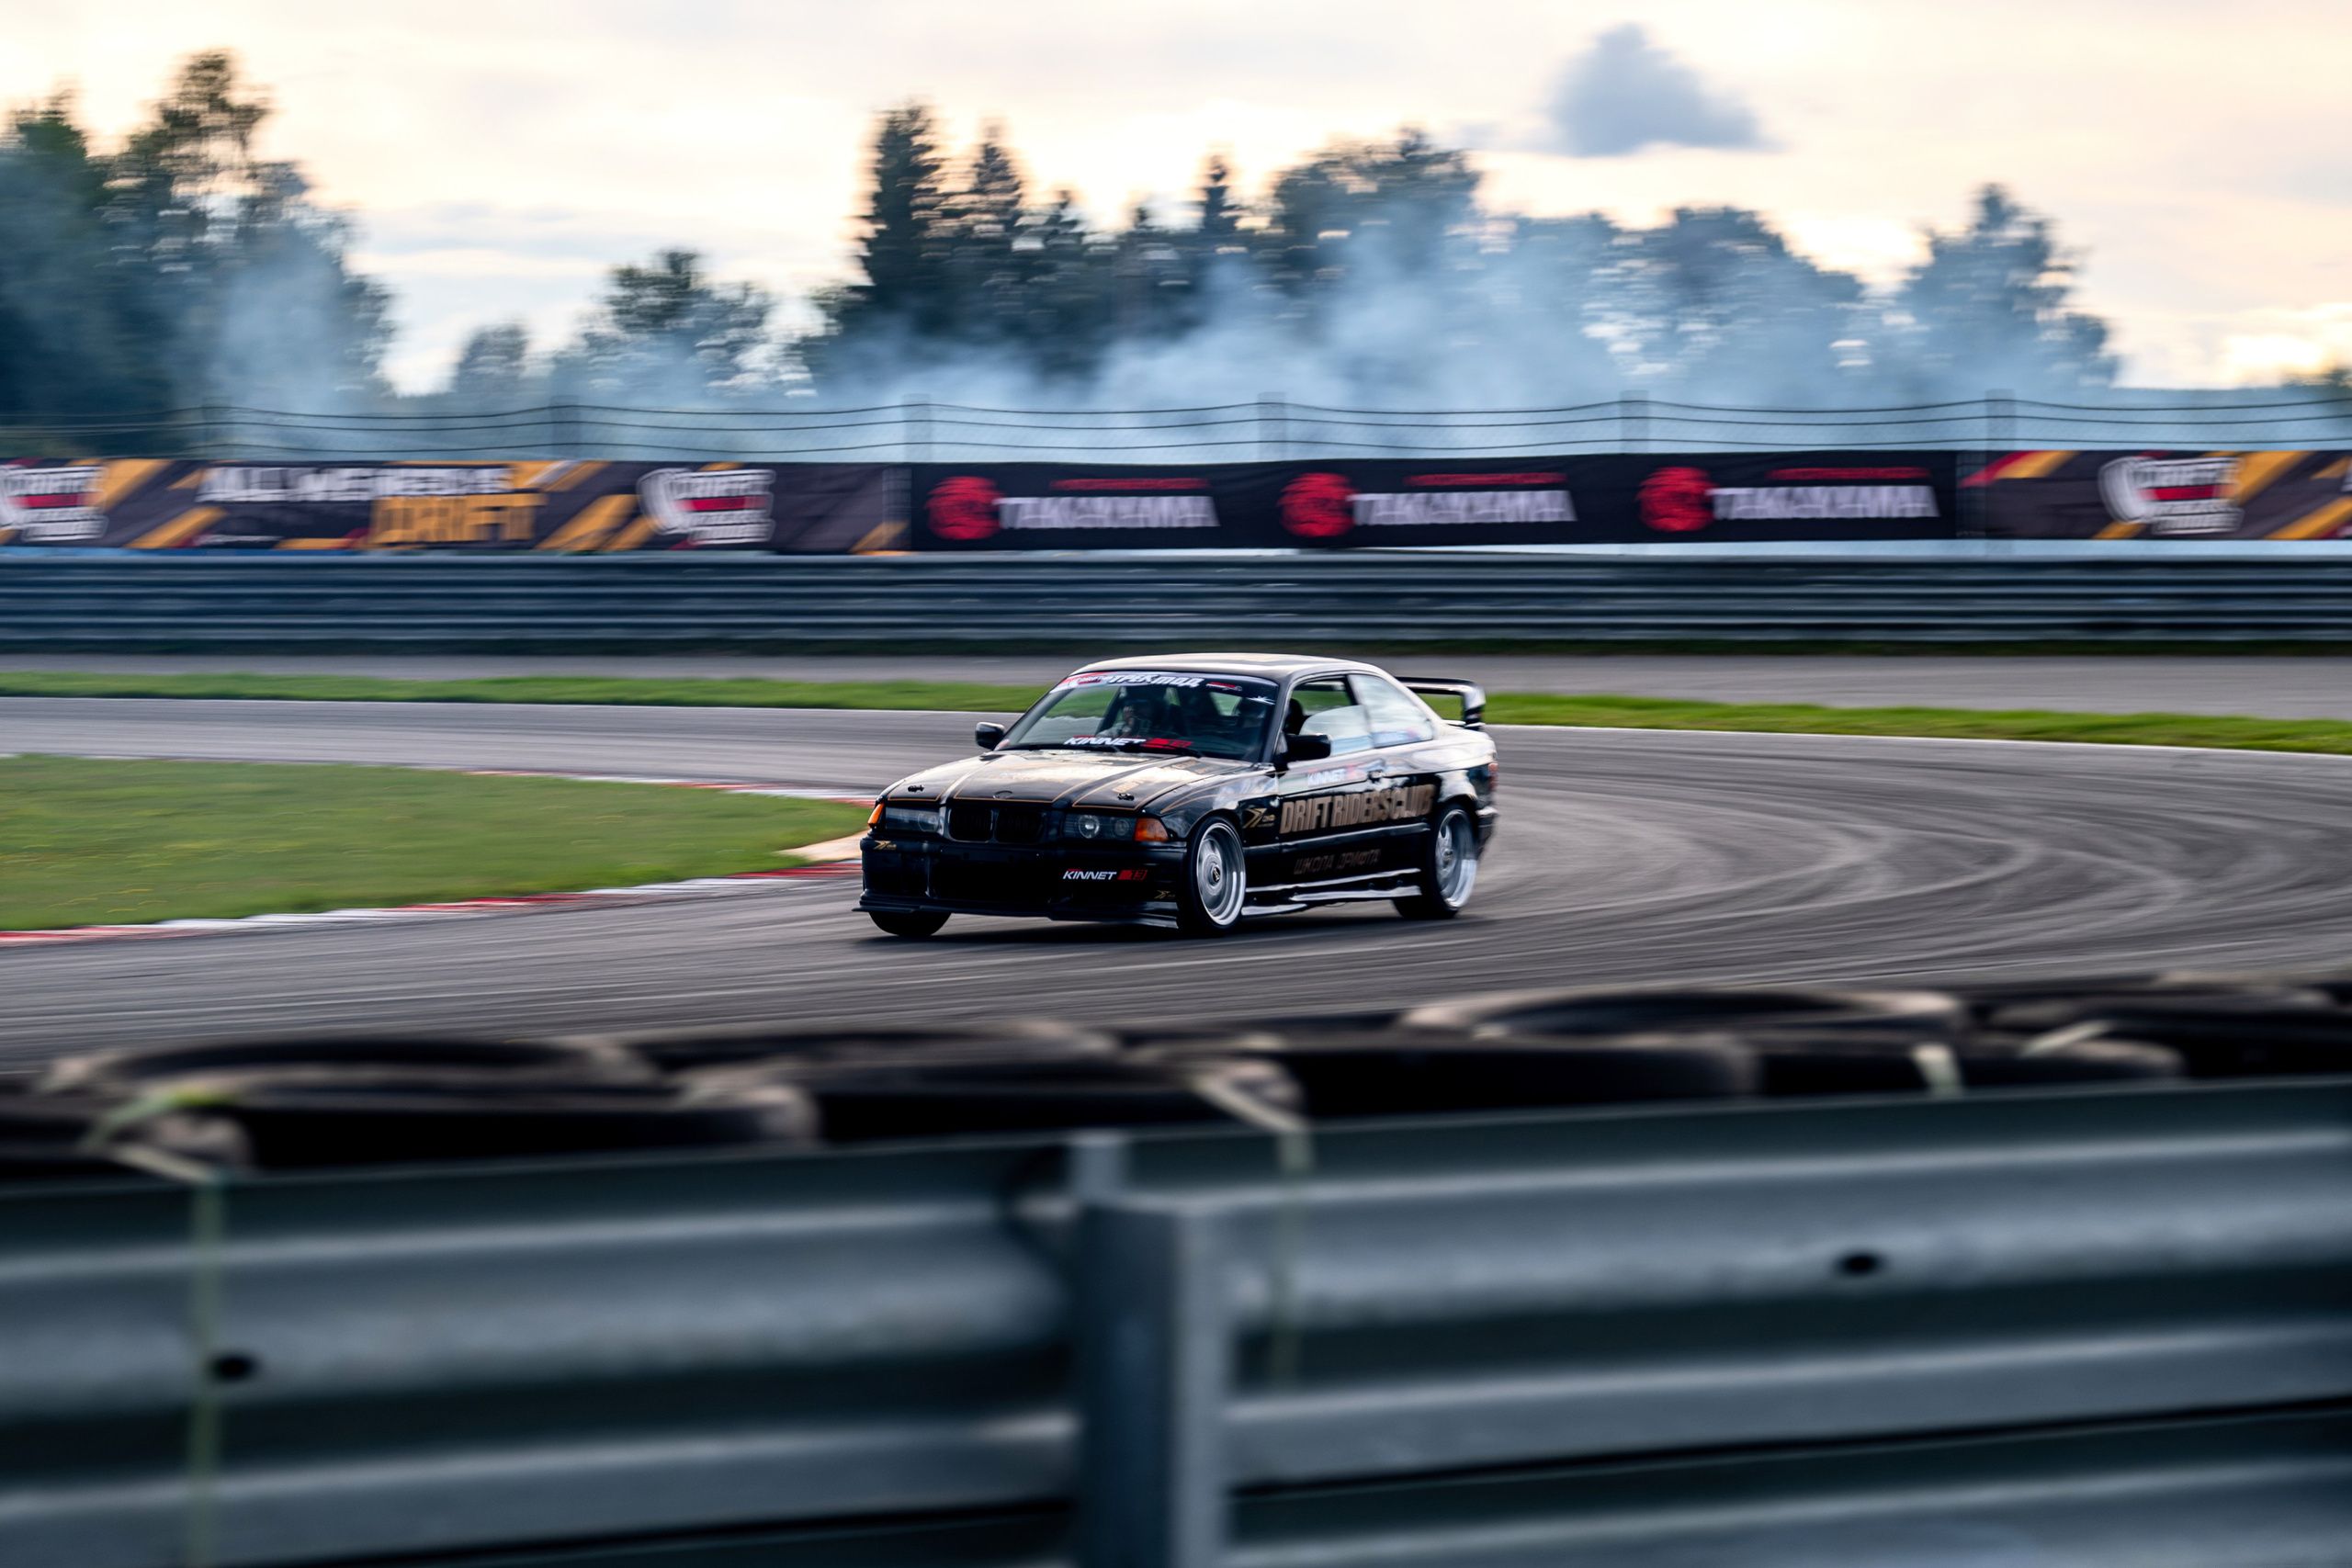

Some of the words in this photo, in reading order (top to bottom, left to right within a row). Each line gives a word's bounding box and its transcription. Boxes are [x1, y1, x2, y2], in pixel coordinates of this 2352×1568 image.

[1064, 737, 1147, 747] KINNET
[1279, 796, 1332, 833] DRIFT
[1063, 870, 1117, 881] KINNET
